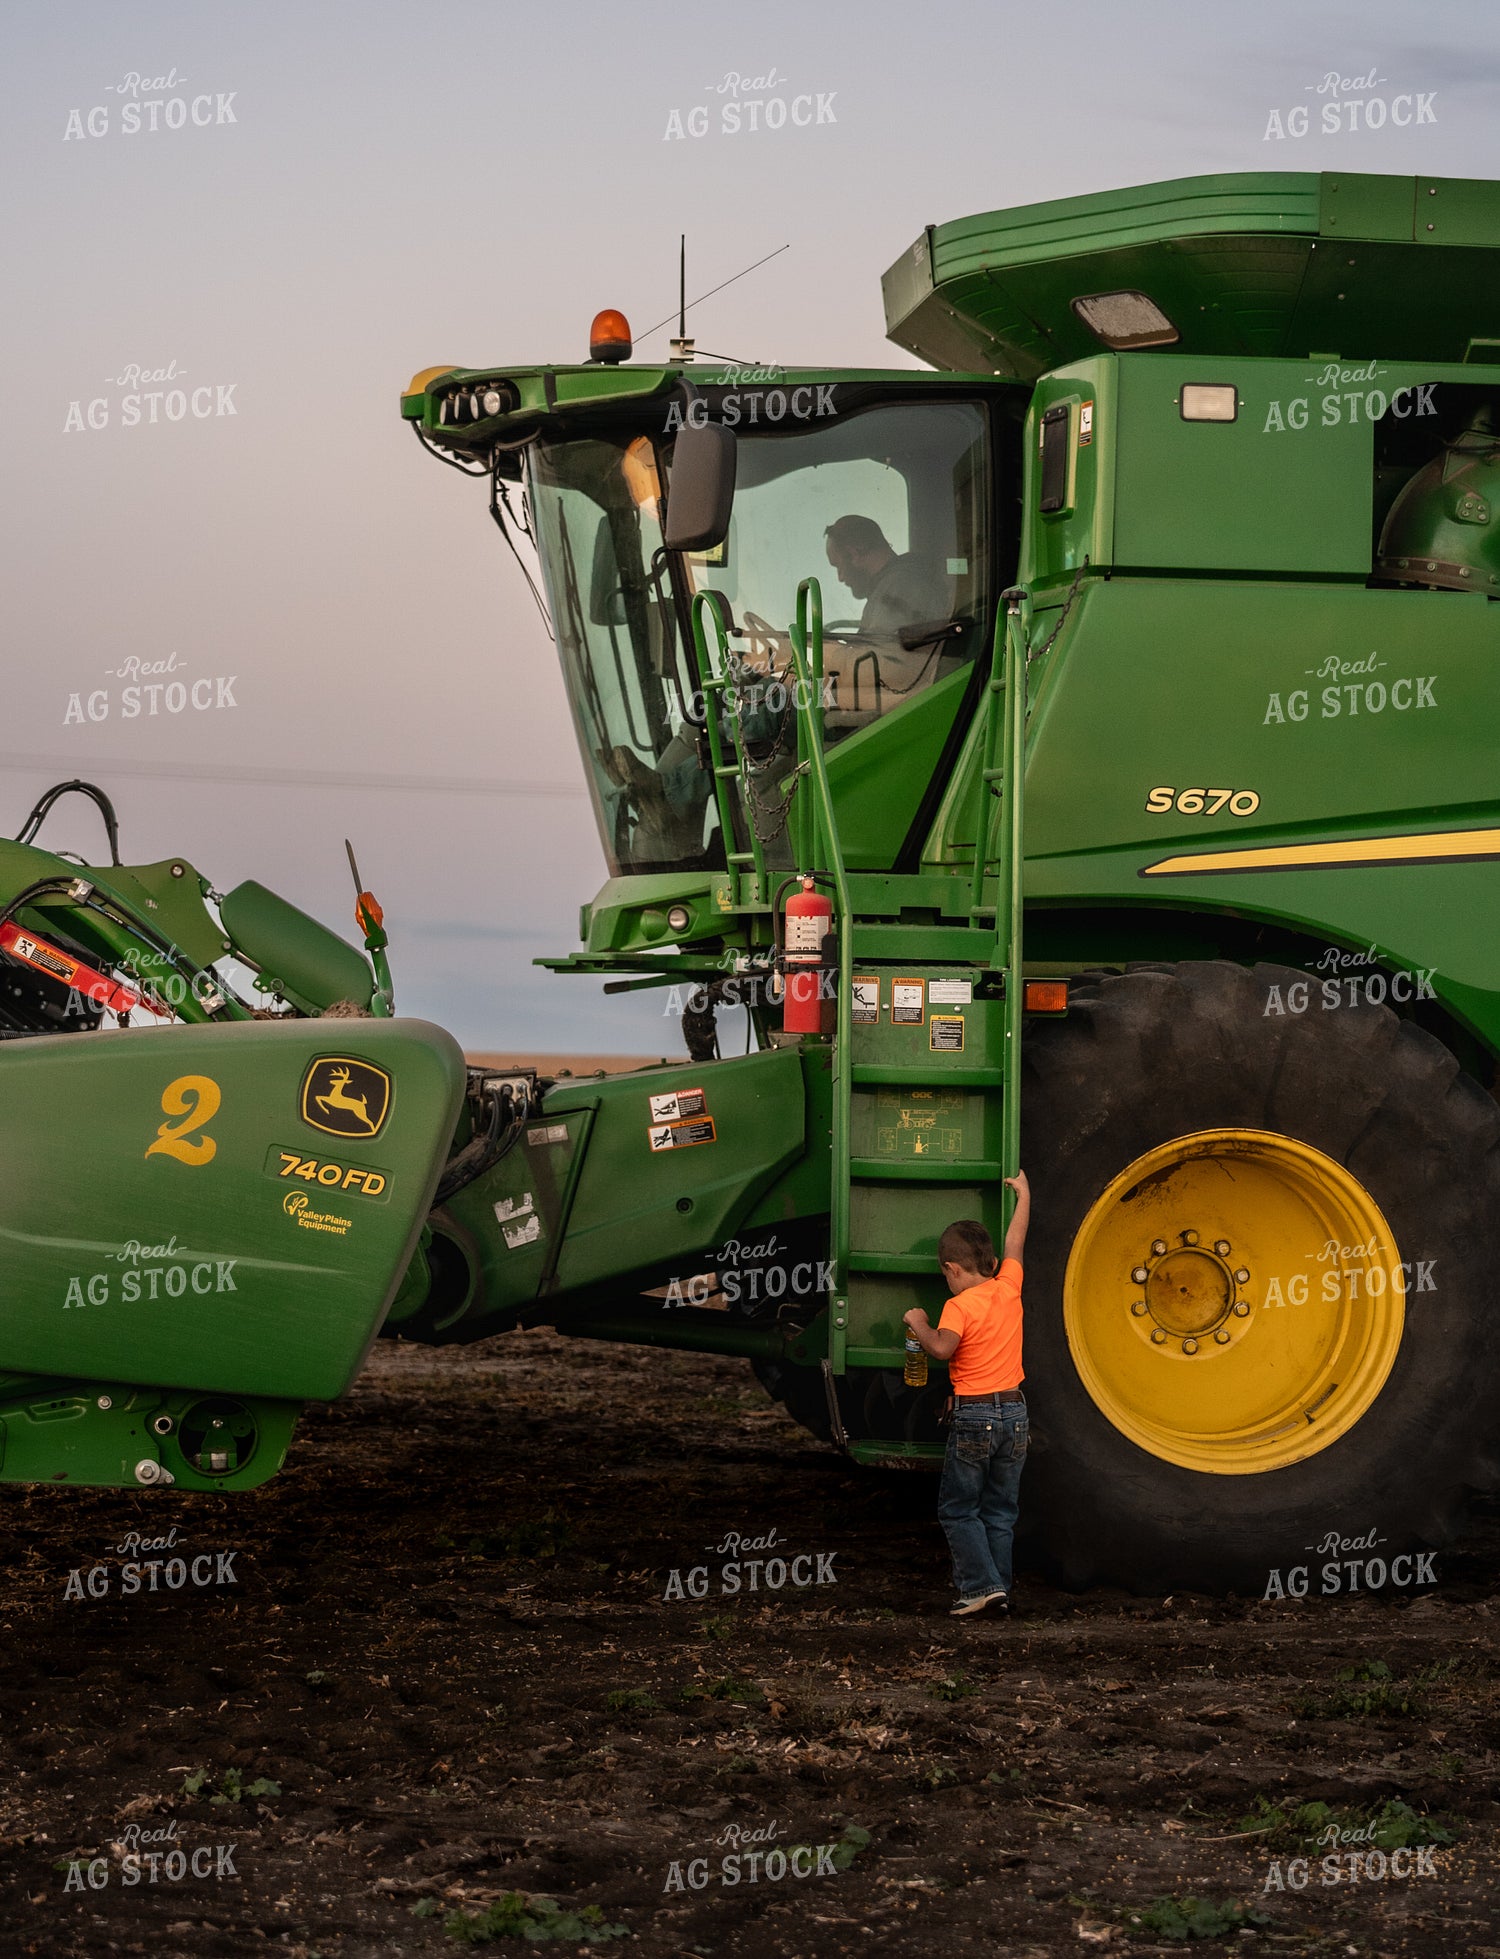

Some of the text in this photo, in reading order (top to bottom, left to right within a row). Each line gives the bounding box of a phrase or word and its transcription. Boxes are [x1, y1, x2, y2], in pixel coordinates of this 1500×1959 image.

[1145, 786, 1261, 817] S670
[144, 1074, 222, 1167] 2
[279, 1152, 387, 1196] 740FD
[297, 1208, 352, 1228] Valley Plains
[298, 1217, 347, 1235] Equipment
